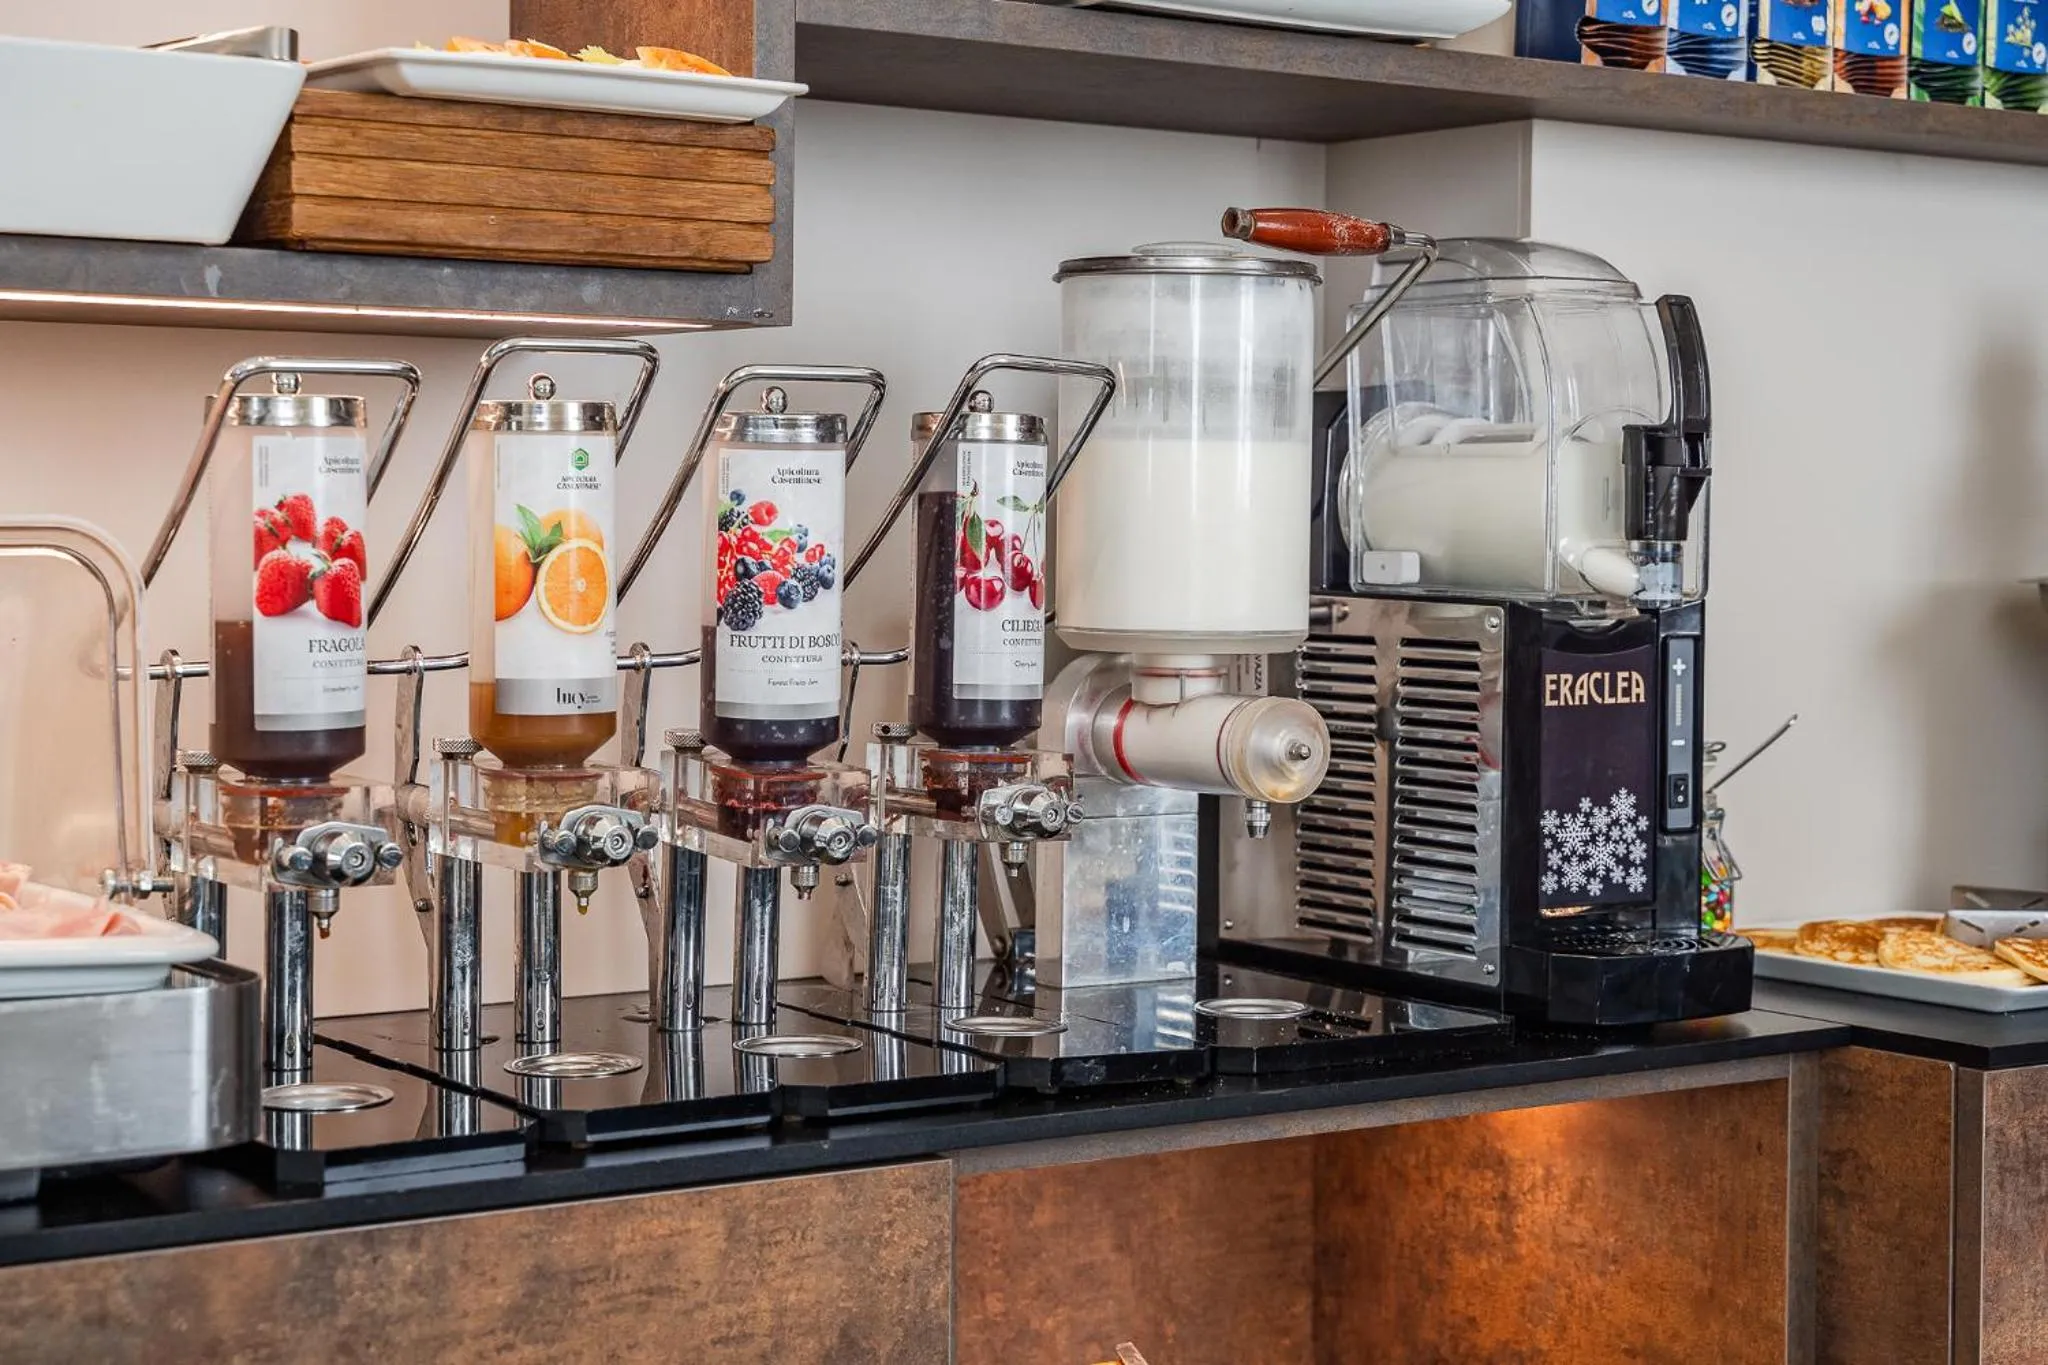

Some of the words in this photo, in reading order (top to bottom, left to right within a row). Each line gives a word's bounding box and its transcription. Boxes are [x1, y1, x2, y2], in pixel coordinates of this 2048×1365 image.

[308, 636, 365, 653] FRAGOL
[730, 633, 785, 649] FRUTTI
[789, 635, 805, 649] DI
[1544, 671, 1645, 706] ERACLEA
